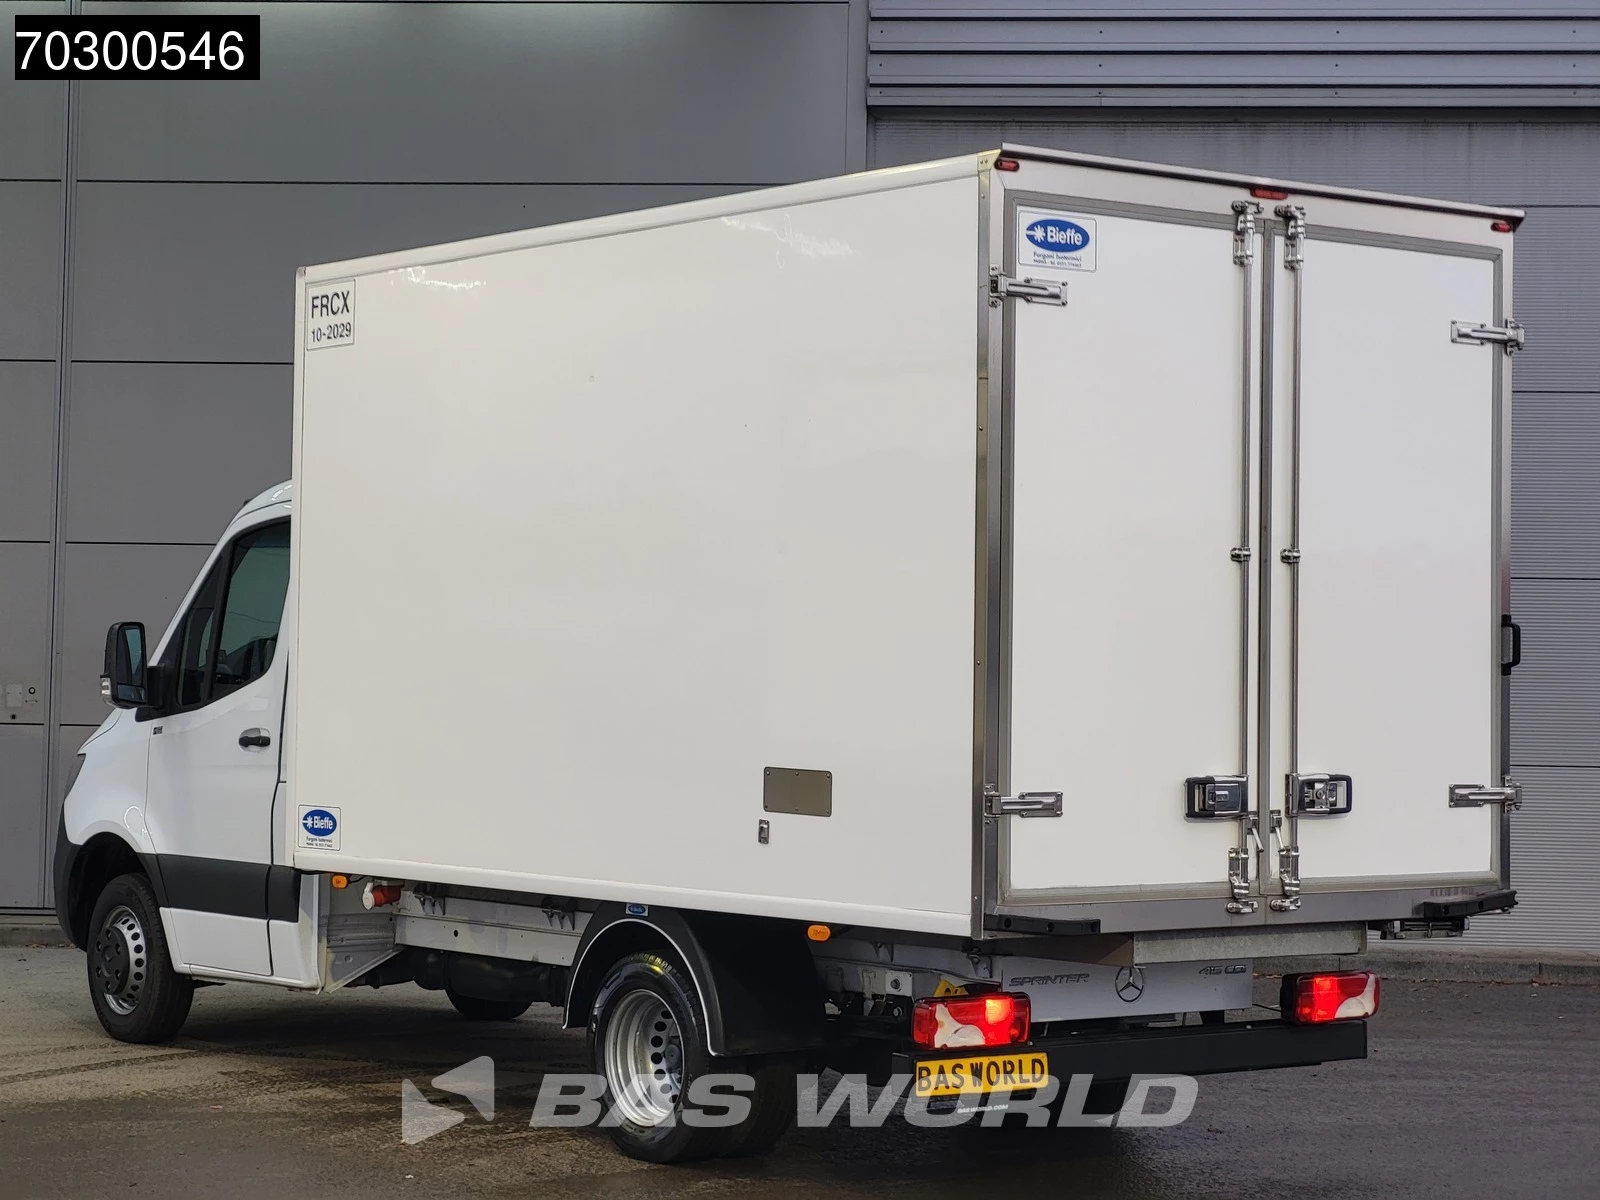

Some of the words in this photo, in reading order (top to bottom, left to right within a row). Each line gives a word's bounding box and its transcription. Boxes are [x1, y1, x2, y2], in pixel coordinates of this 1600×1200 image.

[1046, 225, 1083, 246] Bieffe
[311, 290, 350, 319] FRCX
[311, 321, 352, 343] 10-2029
[313, 816, 334, 830] Bieffe
[1009, 973, 1090, 987] SPRINTER
[917, 1063, 965, 1092] BAS
[970, 1058, 1045, 1088] WORLD
